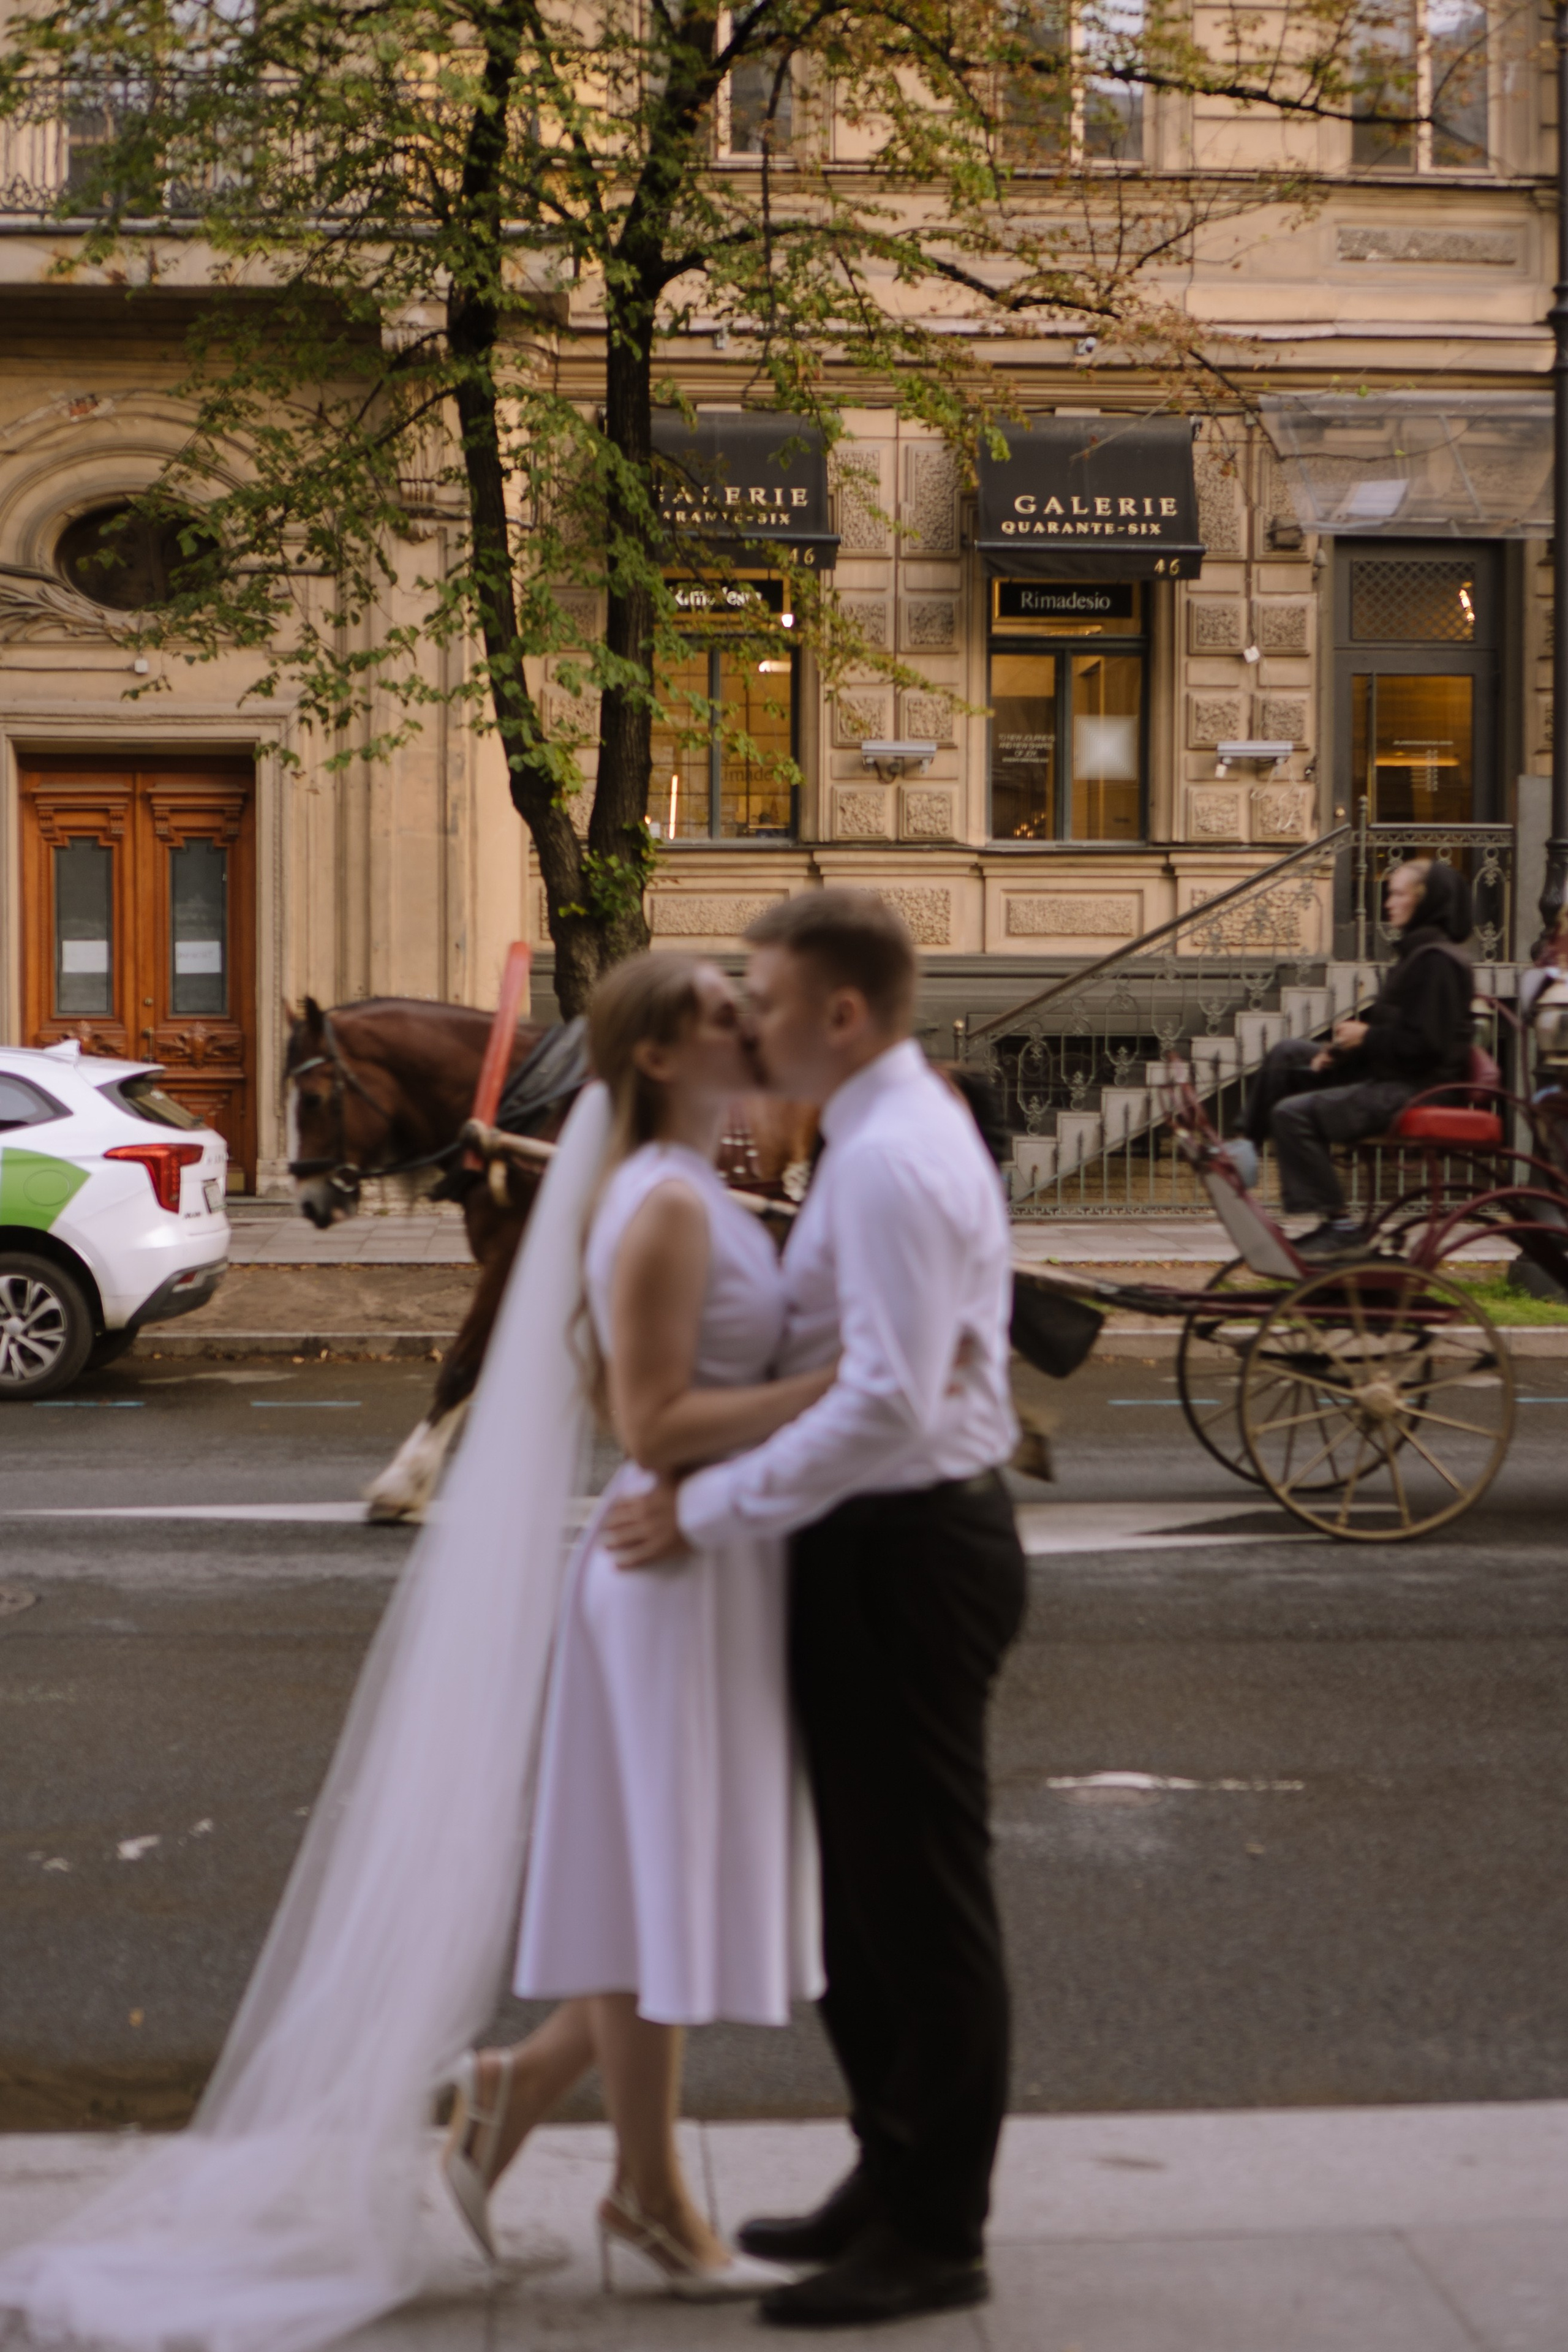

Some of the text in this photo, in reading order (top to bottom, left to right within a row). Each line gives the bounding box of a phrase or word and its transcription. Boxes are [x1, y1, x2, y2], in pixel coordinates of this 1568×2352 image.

[1014, 495, 1178, 516] GALERIE
[1001, 520, 1162, 536] QUARANTE-SIX
[788, 548, 815, 565] 46
[1154, 558, 1181, 576] 46
[1020, 590, 1111, 610] Rimadesio
